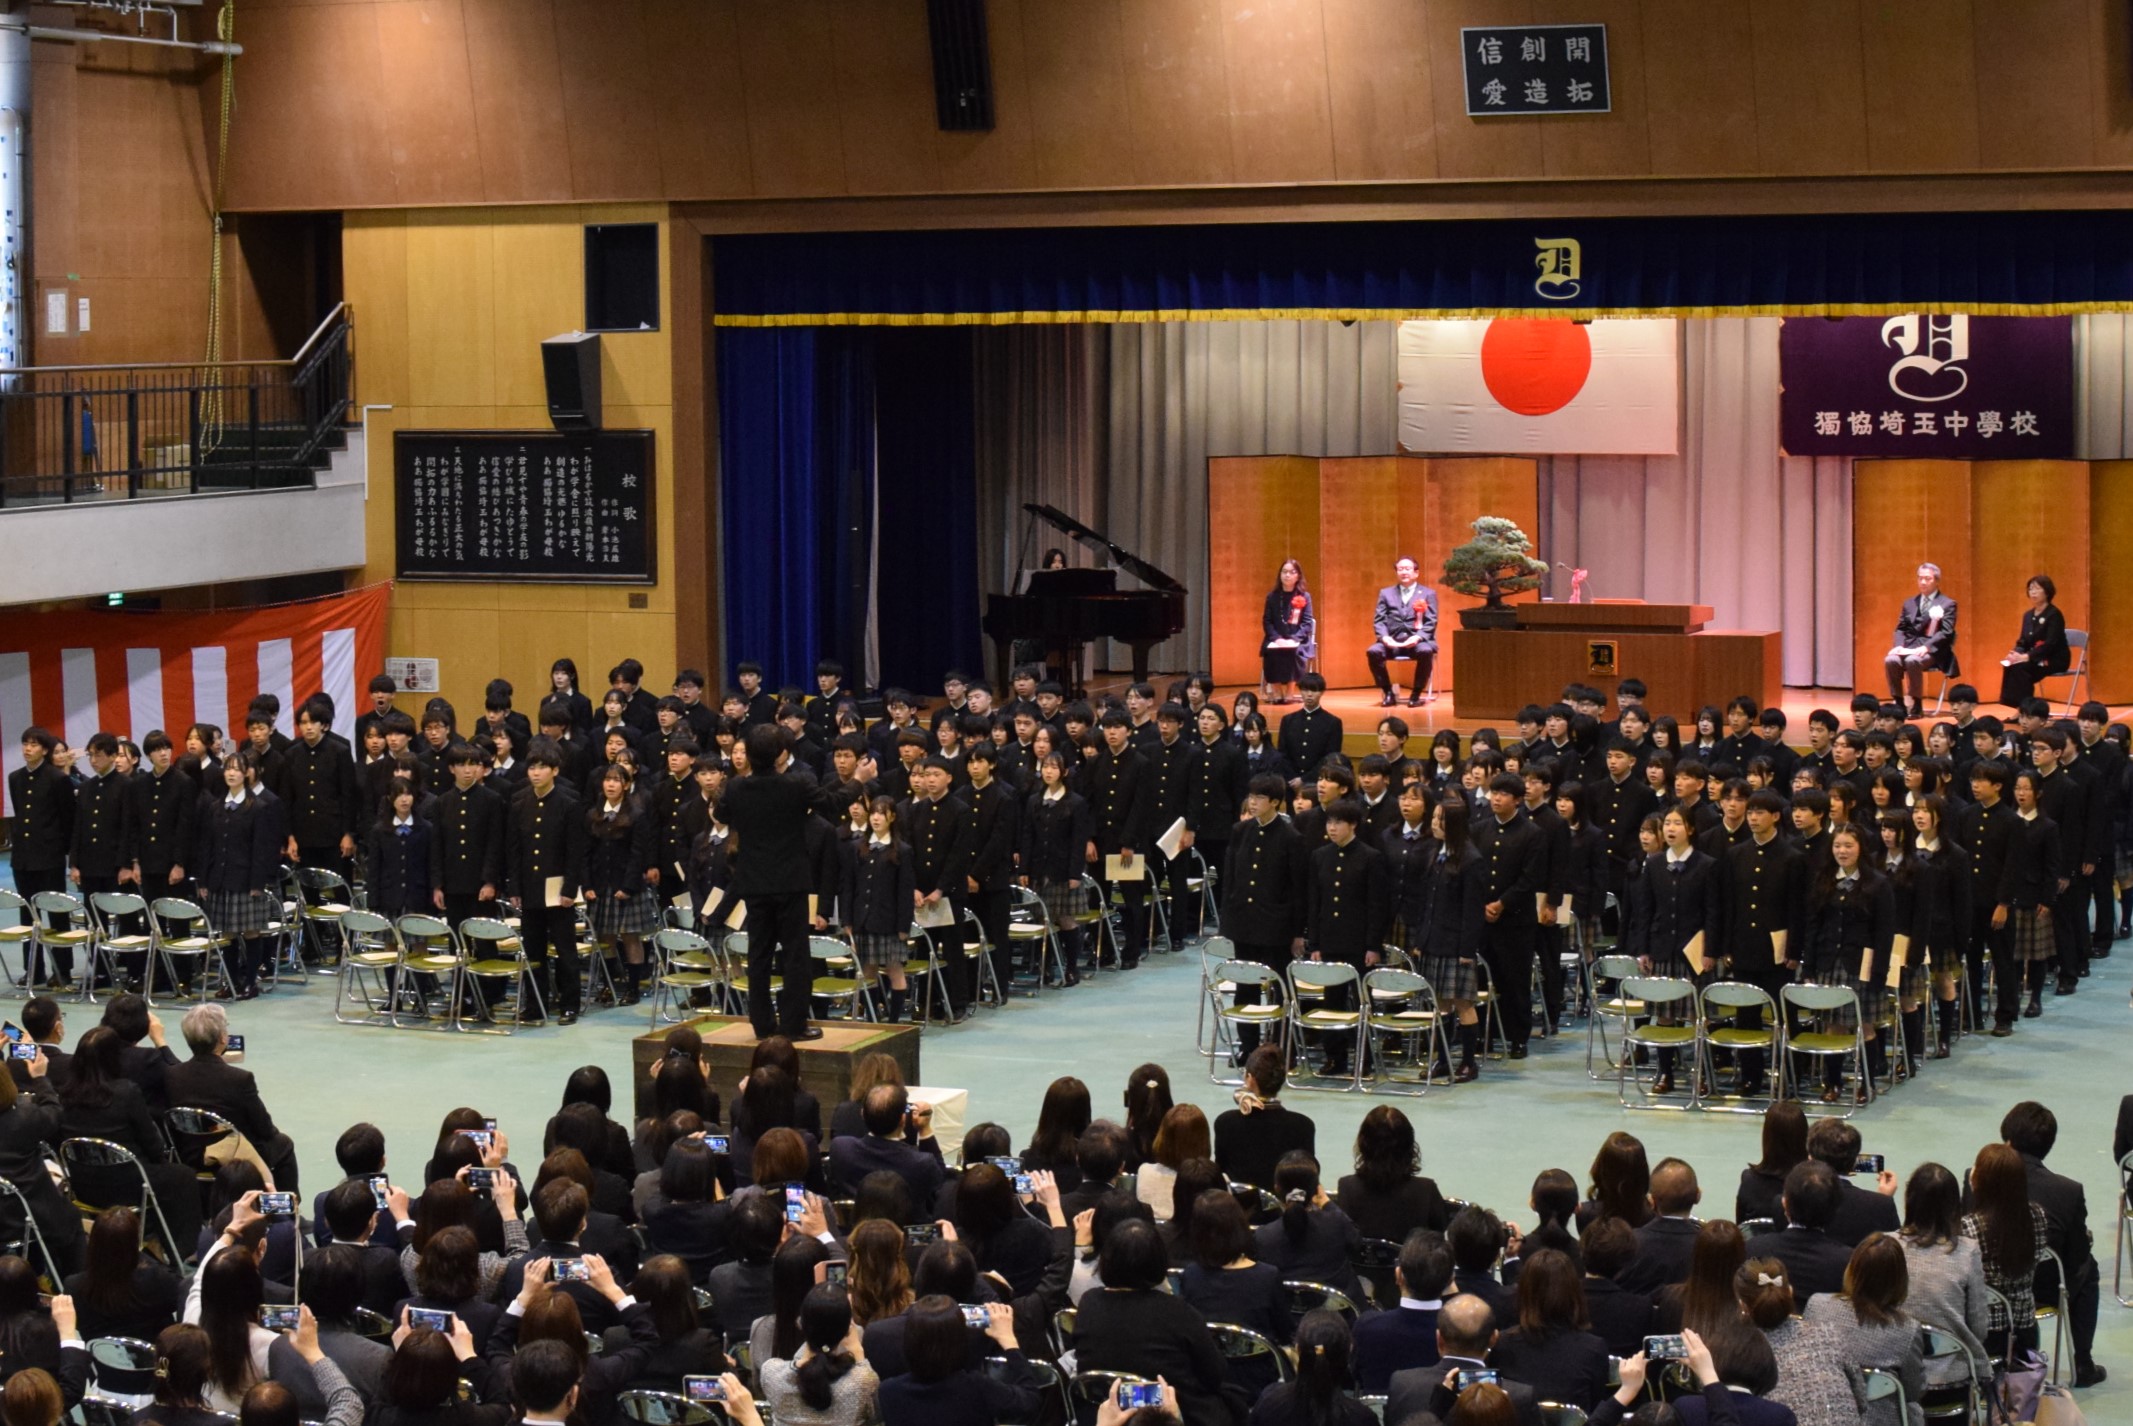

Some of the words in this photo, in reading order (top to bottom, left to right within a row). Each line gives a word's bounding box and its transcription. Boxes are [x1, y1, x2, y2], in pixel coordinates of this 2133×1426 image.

[1535, 236, 1580, 299] D
[1813, 409, 2041, 438] 獨協埼玉中學校
